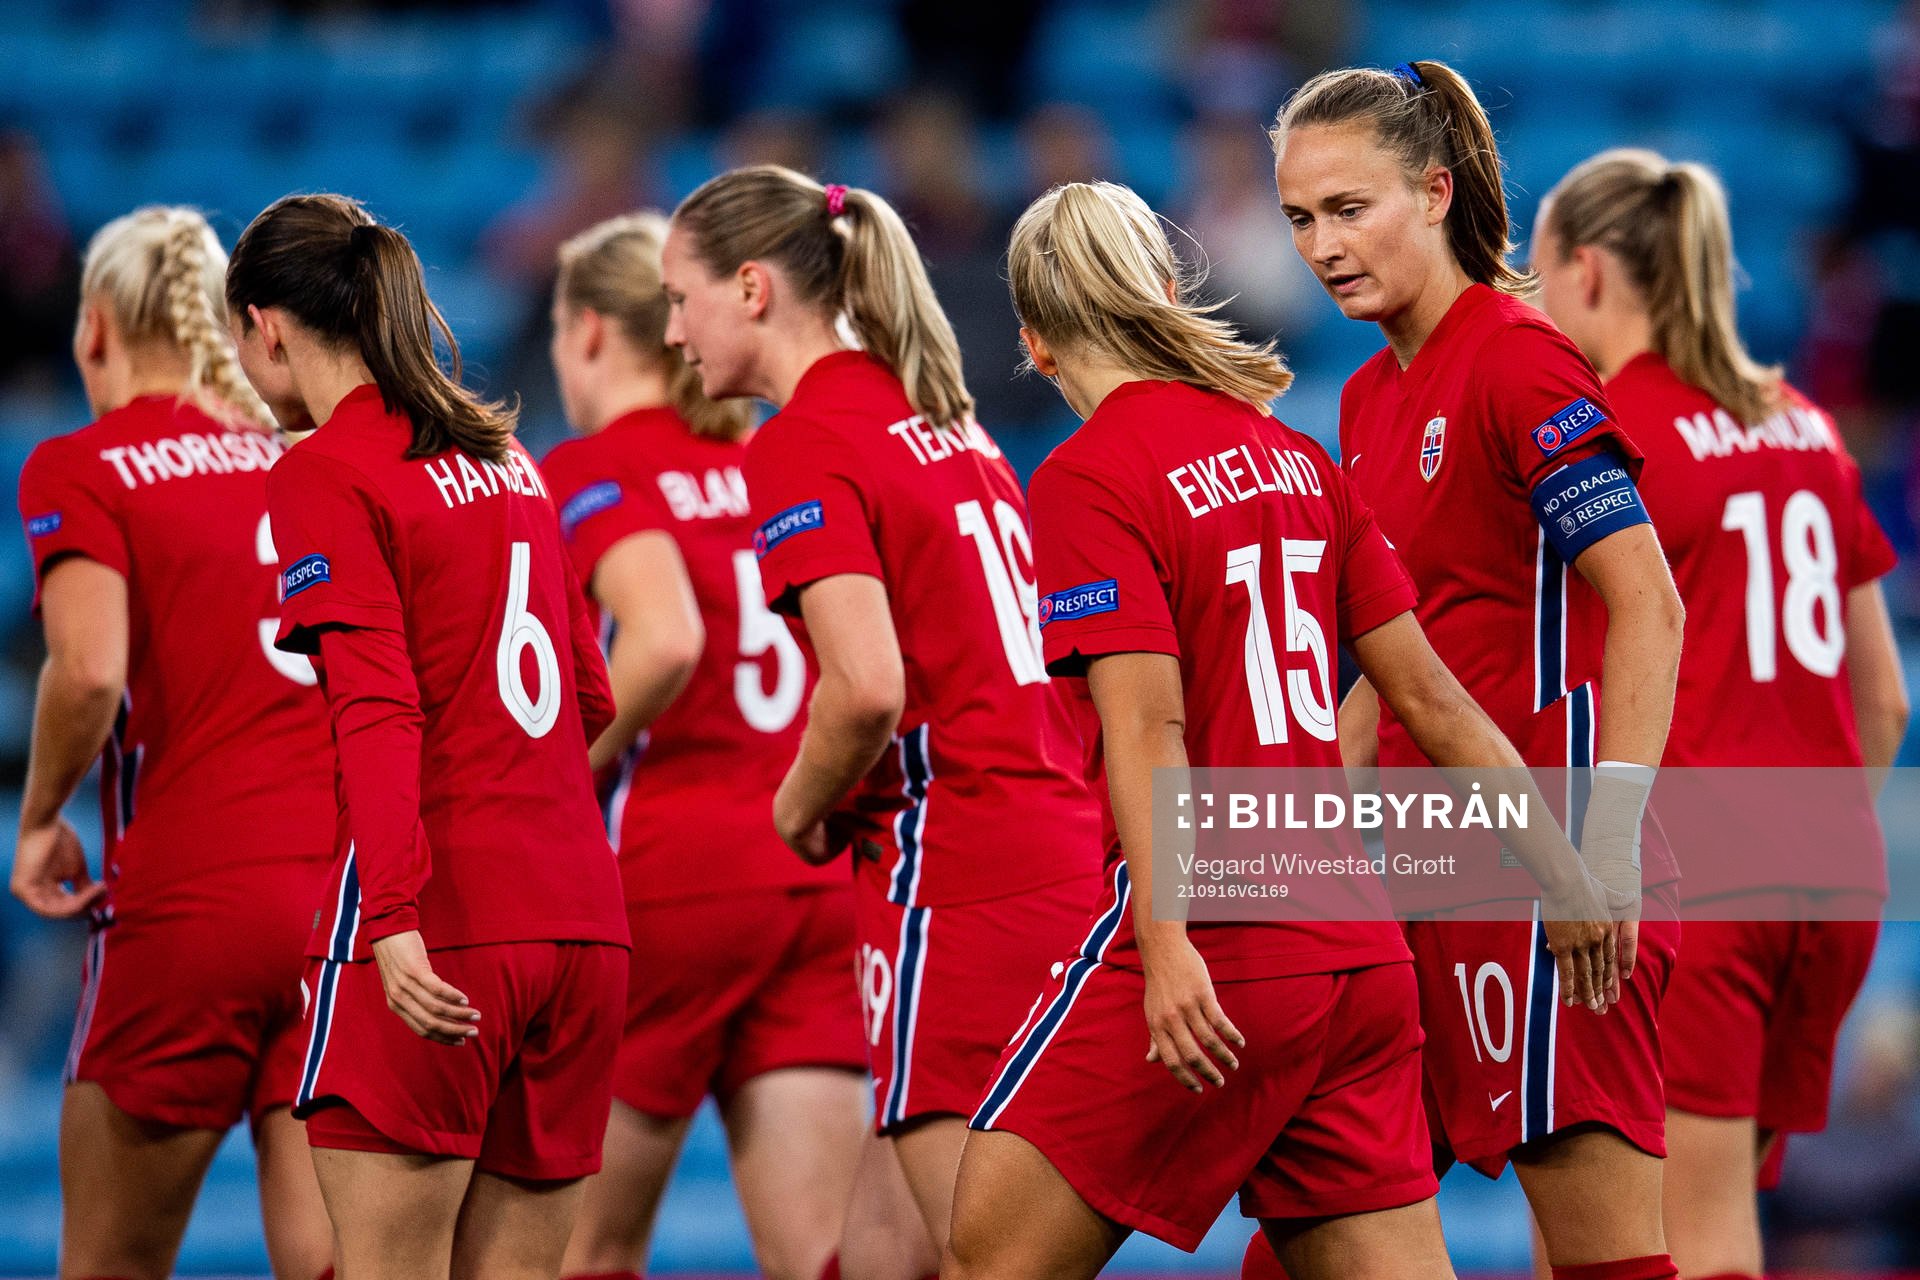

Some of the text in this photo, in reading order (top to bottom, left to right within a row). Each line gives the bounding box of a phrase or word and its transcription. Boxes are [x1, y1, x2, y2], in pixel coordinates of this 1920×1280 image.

[424, 449, 547, 508] HANSEN
[1166, 444, 1323, 518] EIKELAND
[1543, 468, 1628, 517] NO TO RACISM
[1576, 491, 1633, 523] RESPECT
[765, 507, 822, 542] RESPECT
[287, 561, 329, 589] RESPECT
[954, 498, 1051, 686] 19
[1055, 588, 1117, 613] RESPECT
[1721, 488, 1846, 683] 18
[497, 541, 561, 739] 6
[732, 548, 807, 733] 5
[1225, 536, 1338, 746] 15
[1453, 961, 1515, 1064] 10
